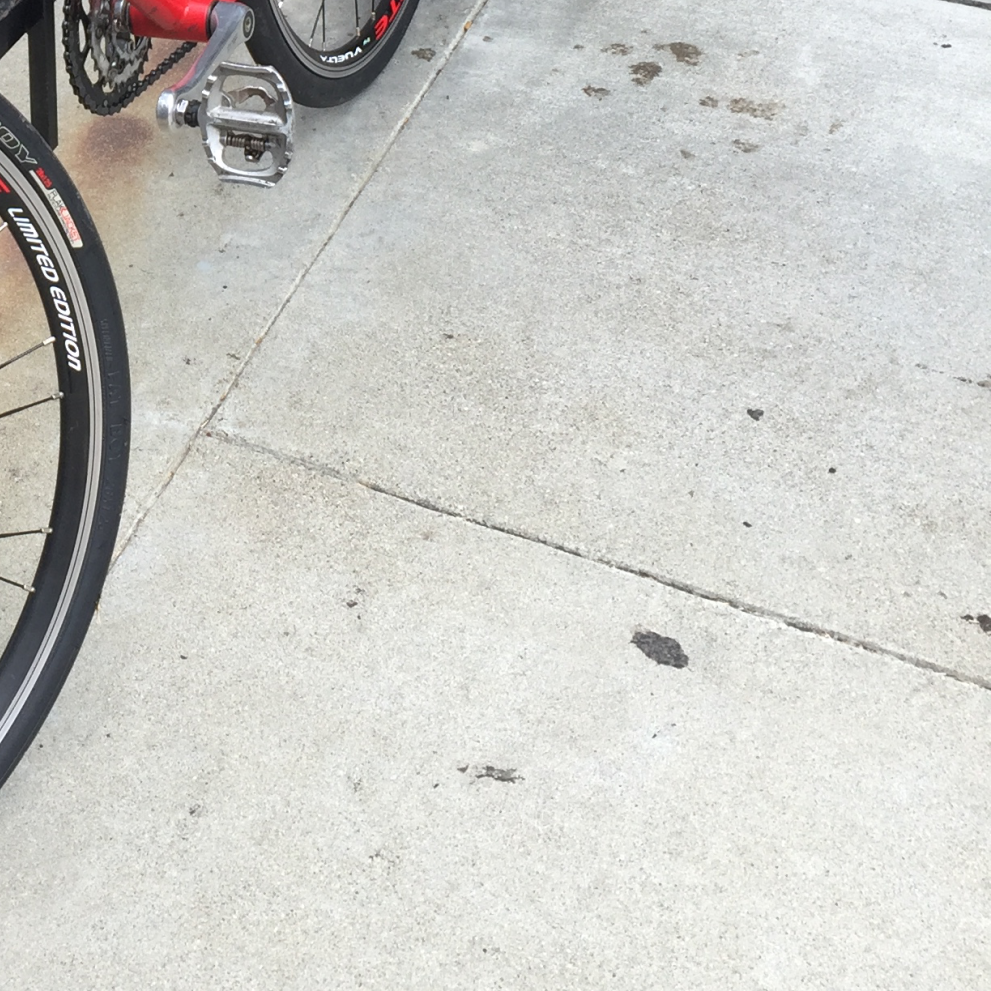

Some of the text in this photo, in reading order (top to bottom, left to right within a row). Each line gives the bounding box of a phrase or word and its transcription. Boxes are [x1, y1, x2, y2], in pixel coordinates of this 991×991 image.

[320, 46, 363, 64] VUELTA
[8, 207, 59, 284] LIMITED
[49, 285, 82, 372] EDITION
